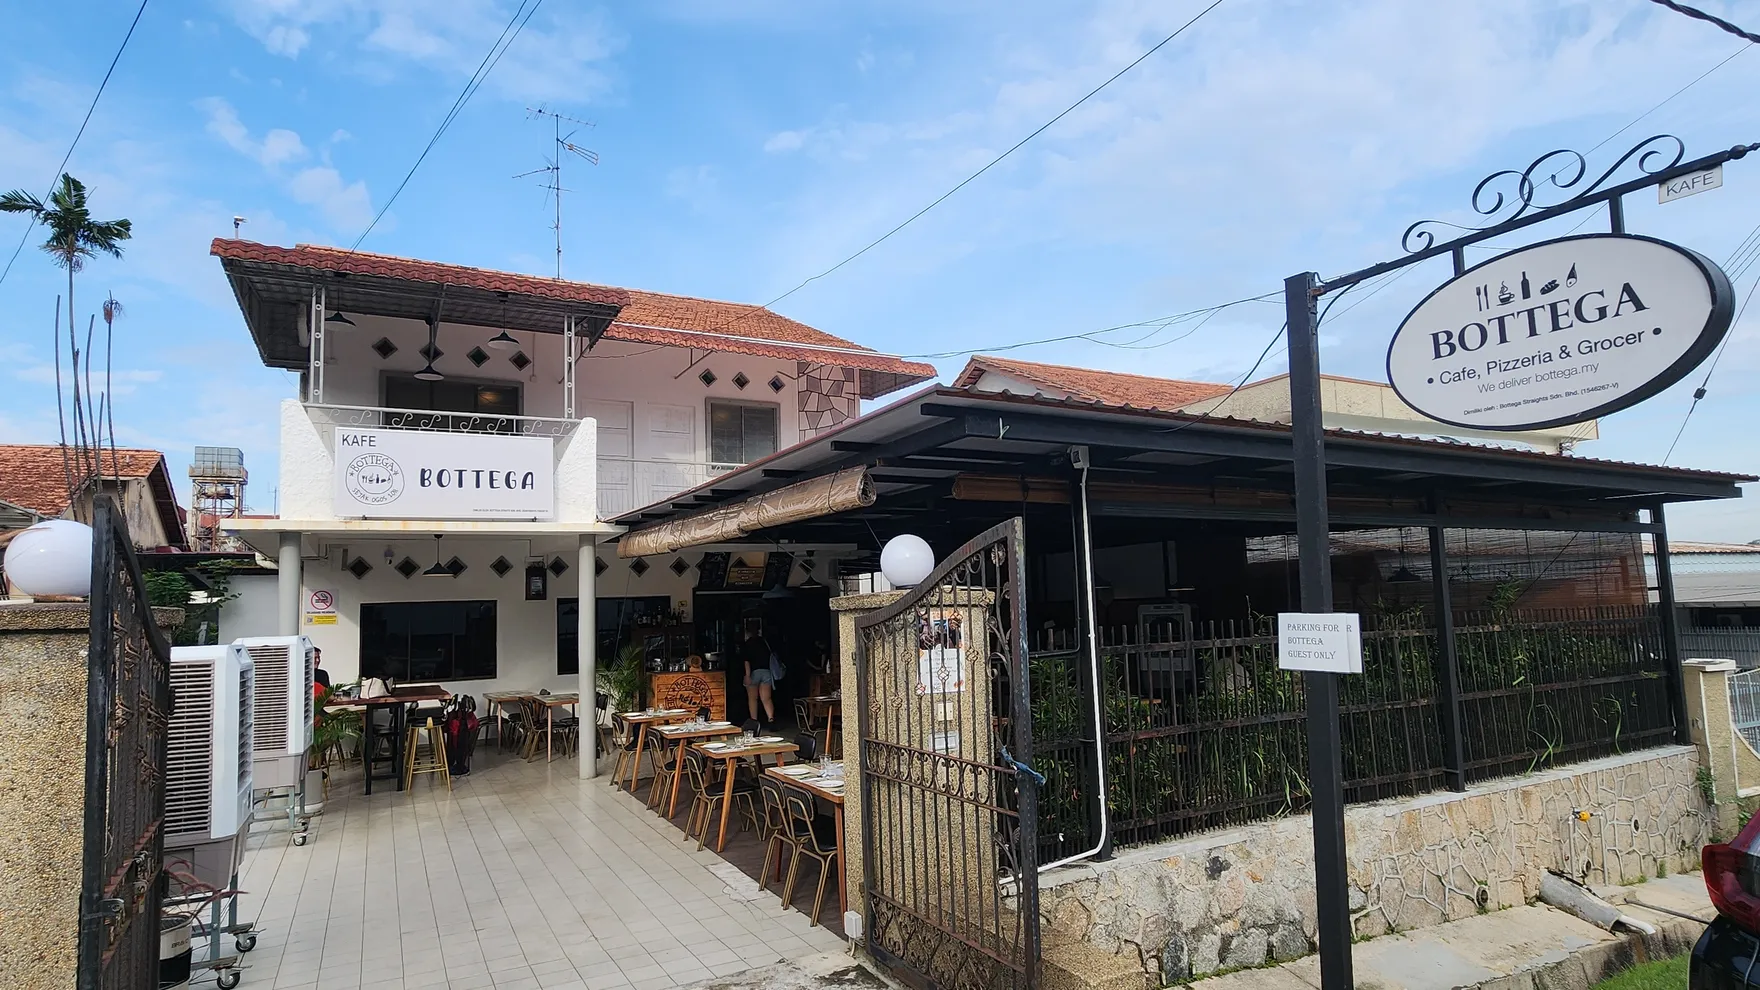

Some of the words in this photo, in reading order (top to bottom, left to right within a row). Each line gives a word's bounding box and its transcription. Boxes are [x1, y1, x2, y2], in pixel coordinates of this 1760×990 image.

[1666, 172, 1714, 196] KAFE
[1429, 282, 1650, 360] BOTTEGA
[1439, 366, 1481, 385] Cafe,
[1486, 350, 1553, 375] Pizzeria
[1558, 345, 1572, 360] &
[1577, 330, 1645, 356] Grocer
[1477, 383, 1496, 394] We
[1498, 376, 1532, 390] deliver
[1535, 362, 1599, 383] bottega.my
[1500, 400, 1521, 409] Bottega
[342, 434, 376, 447] KAFE
[350, 455, 394, 472] BOTTEGA
[420, 468, 535, 490] BOTTEGA
[1287, 624, 1320, 632] PARKING
[1323, 624, 1339, 632] FOR
[1288, 636, 1324, 645] BOTTEGA
[1288, 650, 1312, 658] GUEST
[1314, 651, 1336, 659] ONLY
